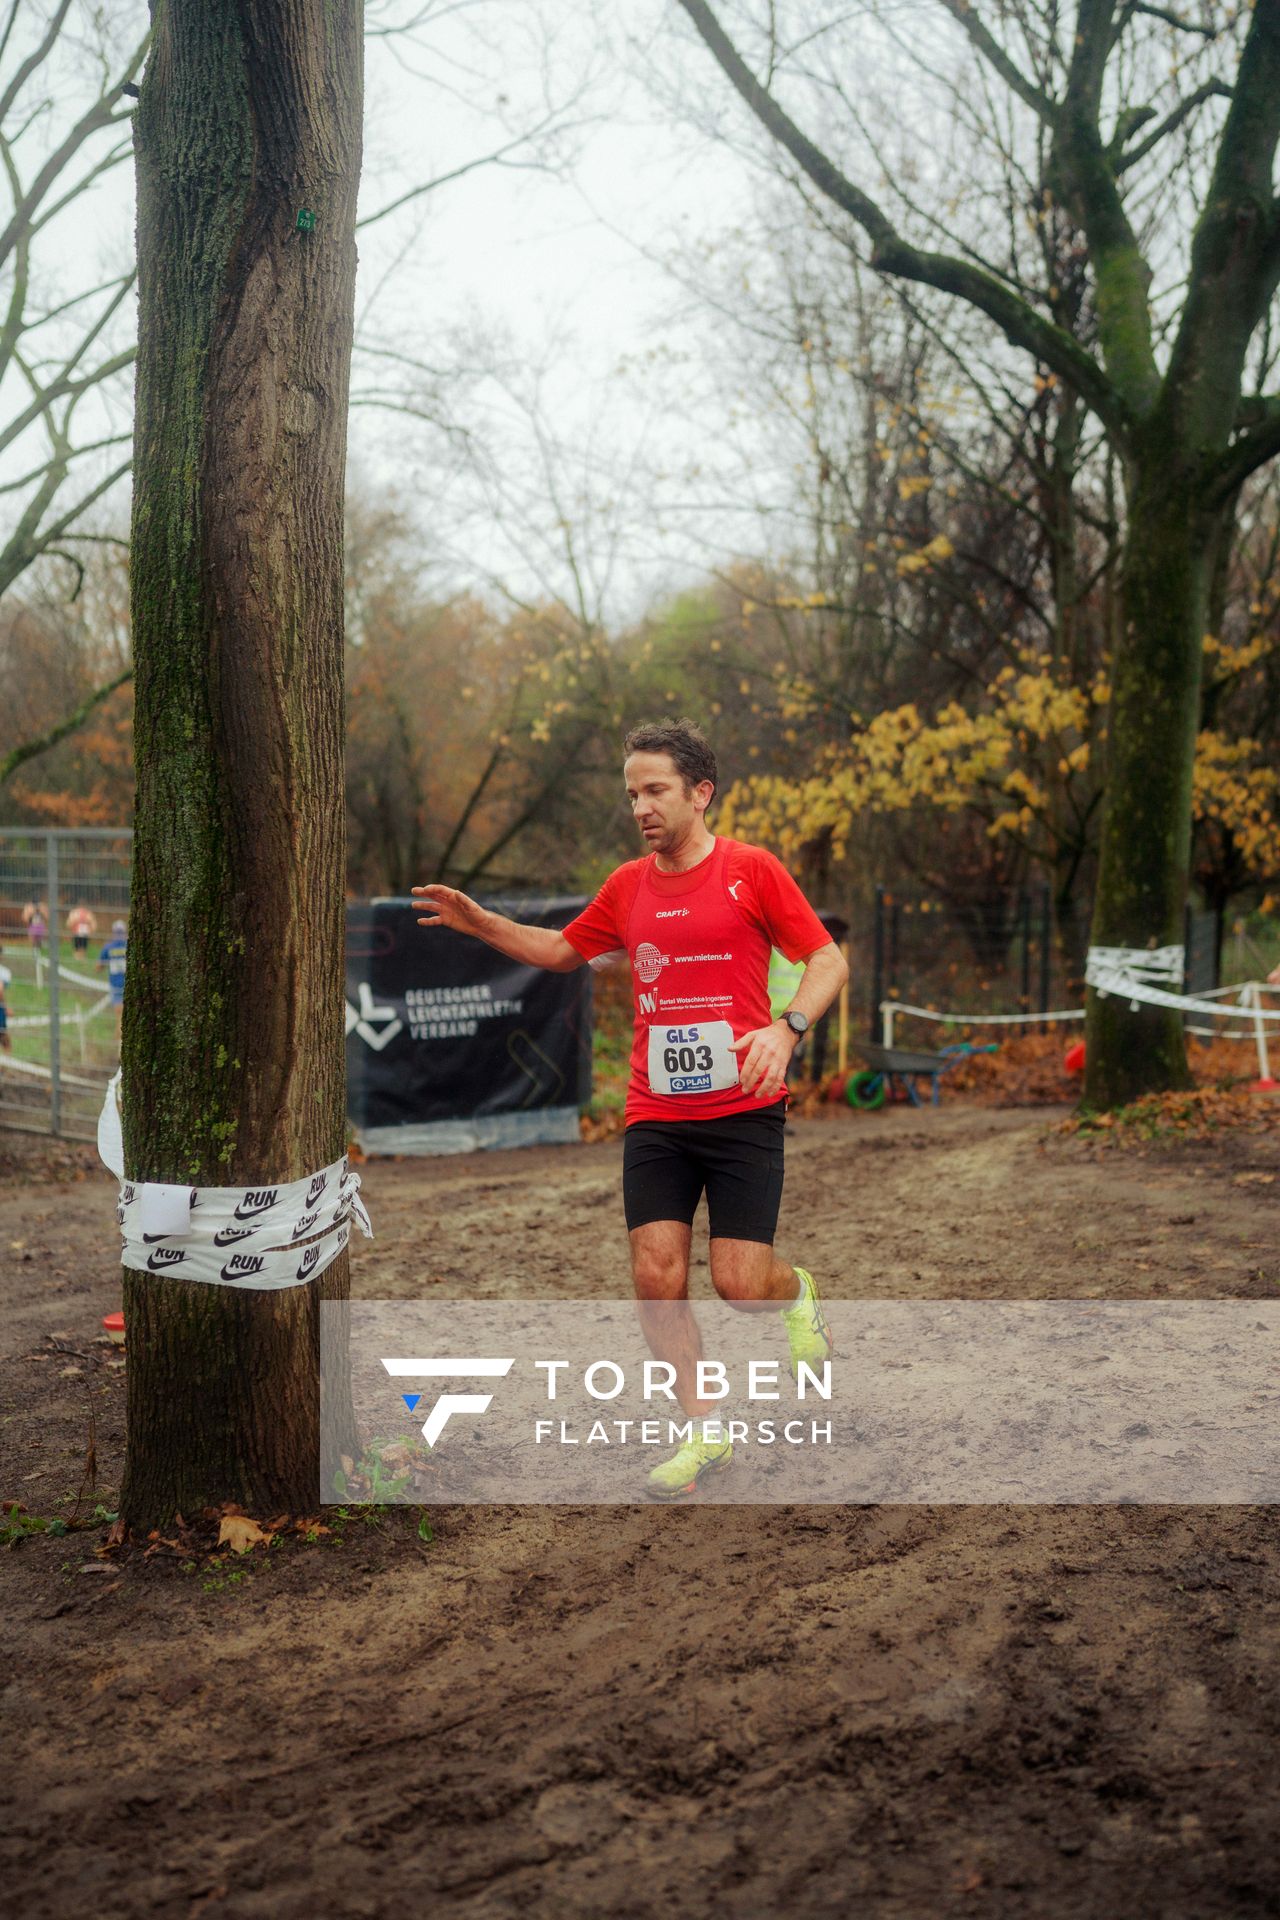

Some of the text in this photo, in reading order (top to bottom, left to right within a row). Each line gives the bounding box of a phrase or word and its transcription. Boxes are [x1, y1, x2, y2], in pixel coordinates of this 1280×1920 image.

[656, 909, 682, 918] CRAFT
[674, 952, 733, 964] www.mietens.de
[405, 985, 491, 1006] DEUTSCHER
[410, 1020, 479, 1040] VERBAND
[666, 1027, 700, 1044] GLS
[663, 1045, 714, 1074] 603
[686, 1077, 710, 1087] PLAN
[309, 1172, 327, 1195] RUN
[242, 1189, 278, 1208] RUN
[154, 1247, 186, 1261] RUN
[229, 1254, 265, 1271] RUN
[303, 1244, 321, 1266] RUN
